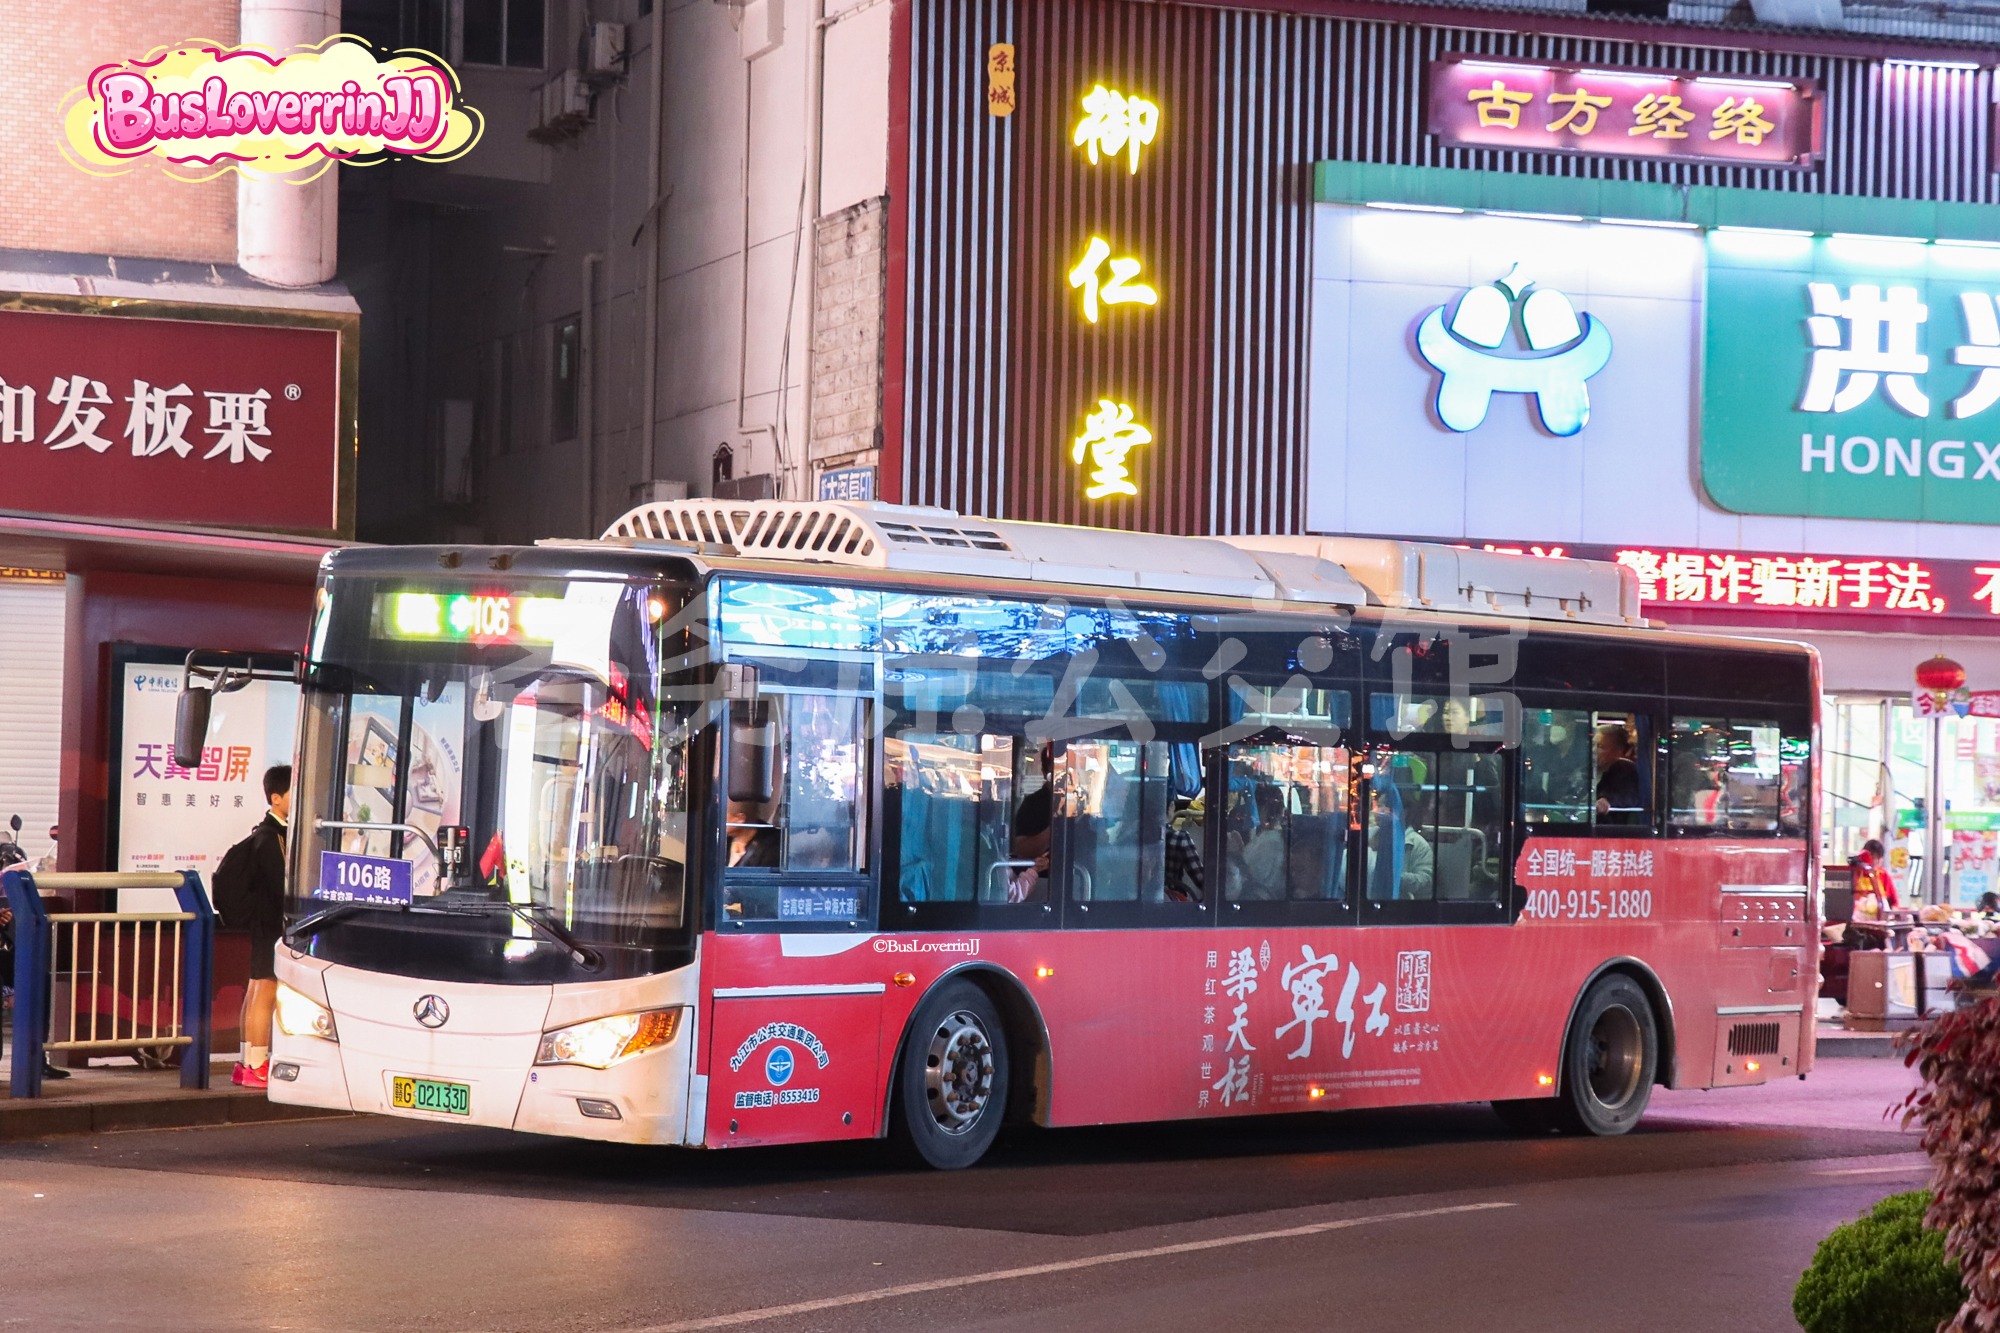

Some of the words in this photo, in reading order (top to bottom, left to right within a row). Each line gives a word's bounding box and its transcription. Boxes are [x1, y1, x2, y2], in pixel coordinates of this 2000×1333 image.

[1468, 80, 1775, 146] 古方经络
[1069, 84, 1160, 499] 御仁堂
[473, 597, 510, 636] 106
[133, 743, 252, 782] 天翼智屏
[337, 860, 391, 891] 106路
[1527, 848, 1653, 877] 全国统一服务热线
[1525, 889, 1651, 918] 400-915-1880
[730, 1022, 829, 1072] 九江市公共交通集团公司
[1198, 950, 1218, 1109] 用红茶观世界
